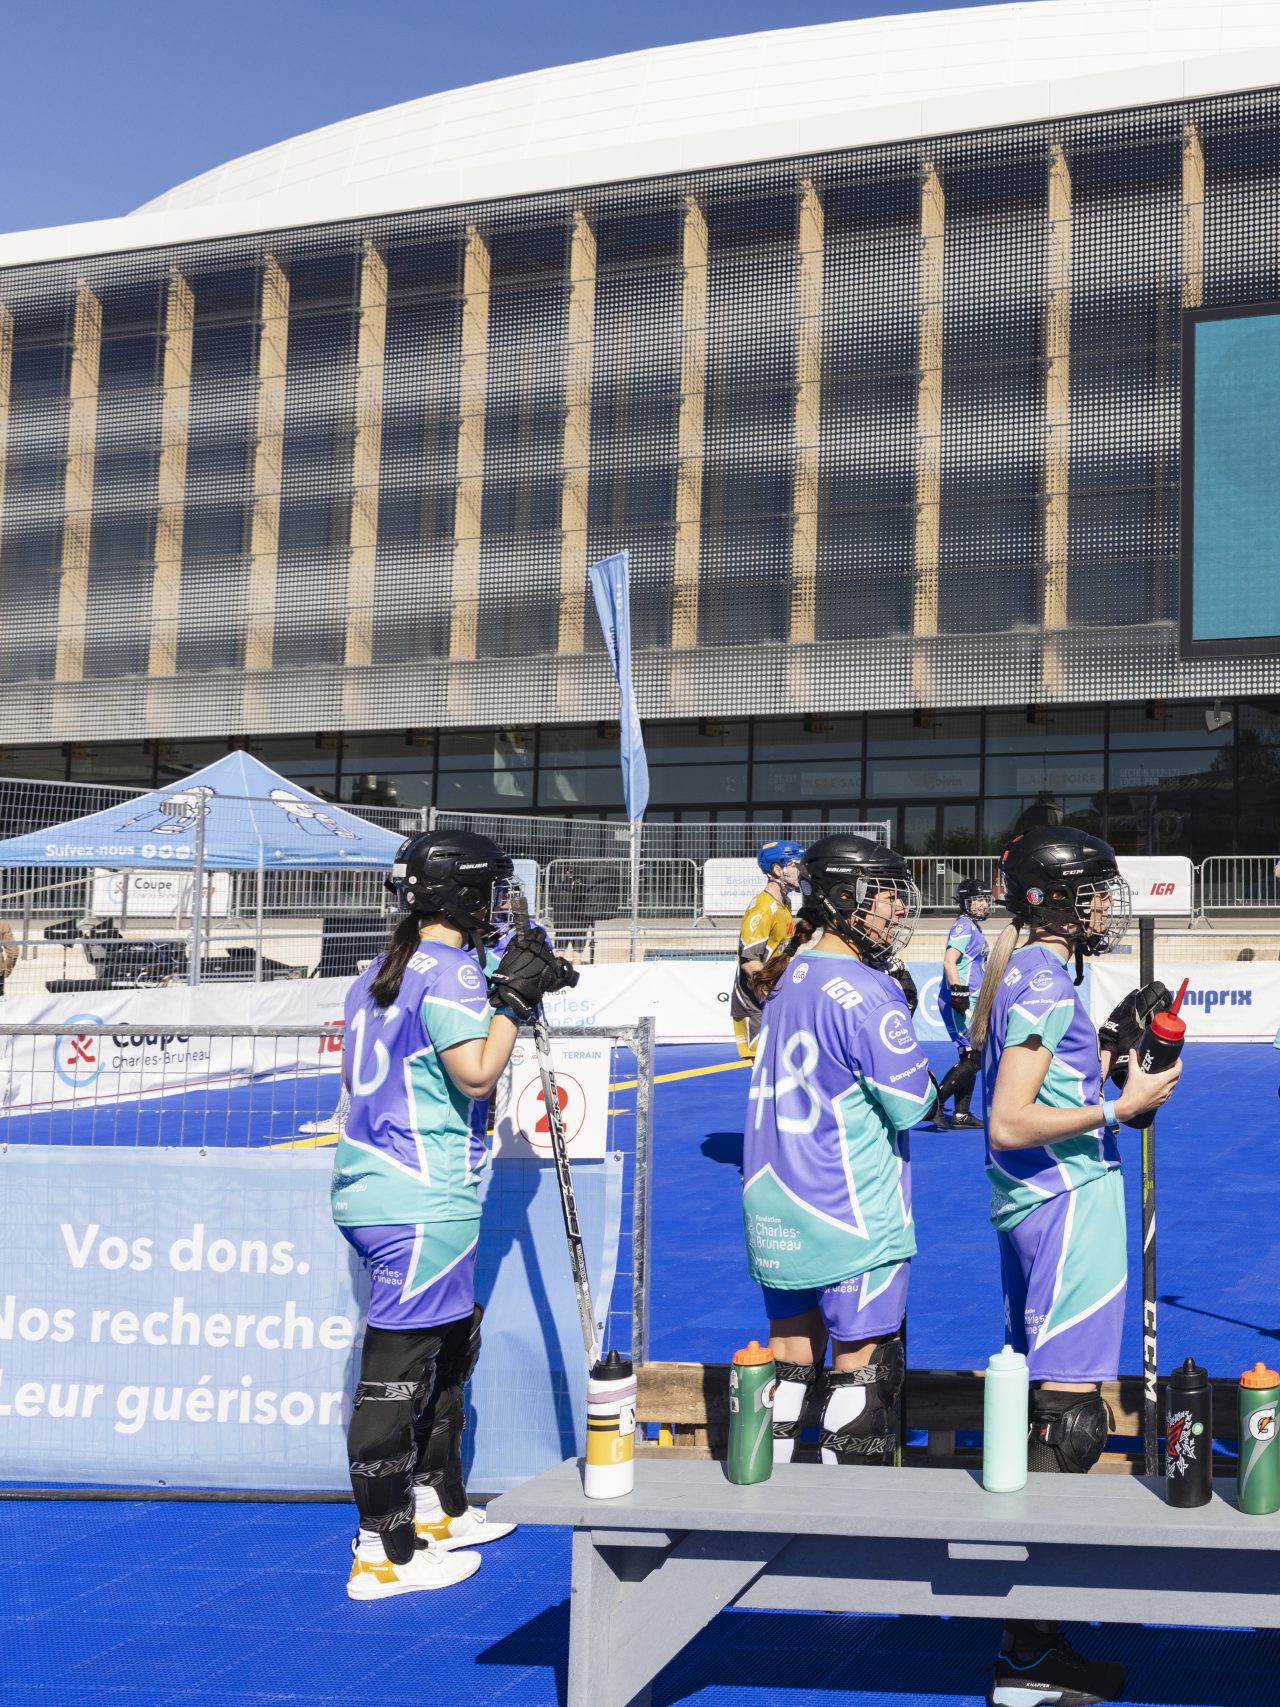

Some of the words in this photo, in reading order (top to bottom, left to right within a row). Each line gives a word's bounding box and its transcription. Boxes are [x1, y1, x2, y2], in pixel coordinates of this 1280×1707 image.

[45, 845, 135, 857] Suivez-nous
[134, 877, 173, 894] Coupe
[726, 877, 768, 886] Ensembl
[1150, 883, 1175, 896] IGA
[821, 977, 864, 1010] IGA
[1171, 990, 1252, 1014] niprix
[318, 1020, 345, 1054] IG
[112, 1048, 211, 1069] Charles-Bruneau
[749, 1025, 819, 1134] 48
[890, 1066, 916, 1083] Banque
[535, 1085, 569, 1133] 2
[756, 1215, 781, 1223] Fondation
[756, 1223, 800, 1238] Charles-
[60, 1224, 154, 1269] Vos
[169, 1224, 310, 1275] dons.
[757, 1237, 800, 1251] Bruneau
[755, 1257, 780, 1269] MNM
[1144, 1300, 1157, 1402] CCM
[1249, 1408, 1276, 1441] G
